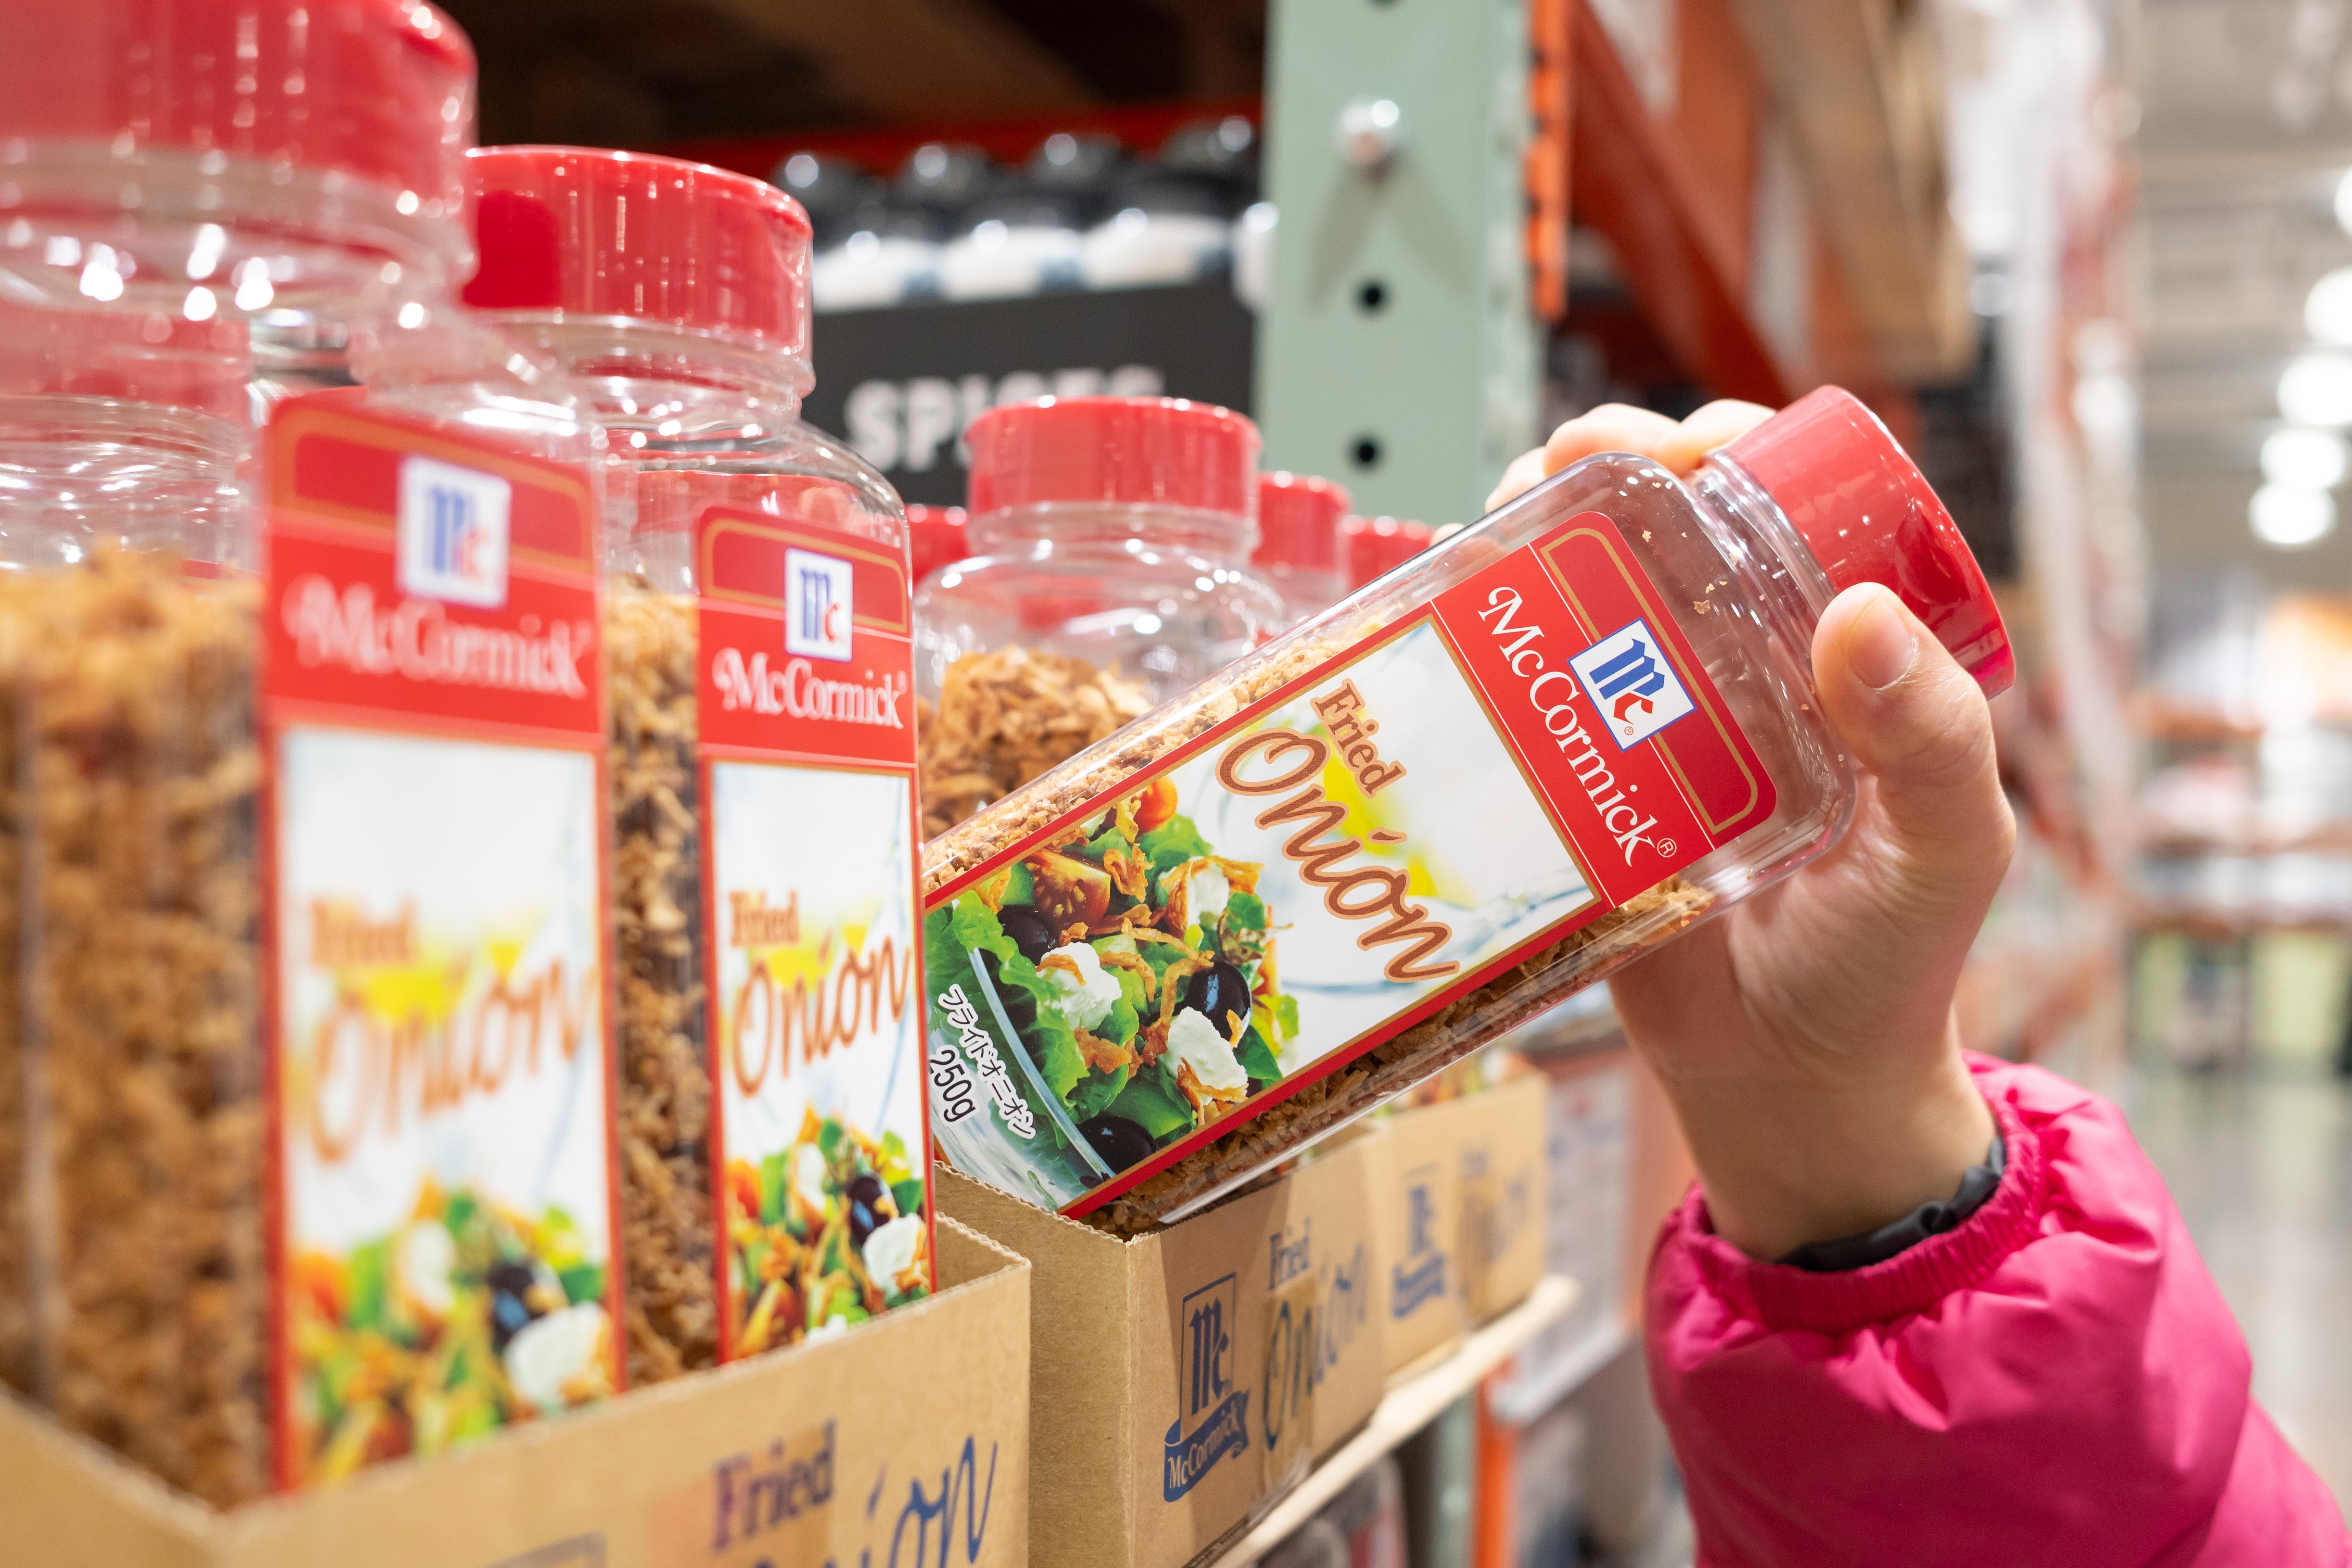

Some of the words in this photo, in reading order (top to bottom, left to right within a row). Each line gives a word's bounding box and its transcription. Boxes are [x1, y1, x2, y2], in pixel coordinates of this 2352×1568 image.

[1310, 678, 1407, 800] Fried
[1215, 727, 1460, 983] Onion
[731, 927, 912, 1100] Onion
[929, 1048, 977, 1123] 250g
[939, 985, 1036, 1138] フライドオニオン
[711, 1416, 836, 1554] Fried
